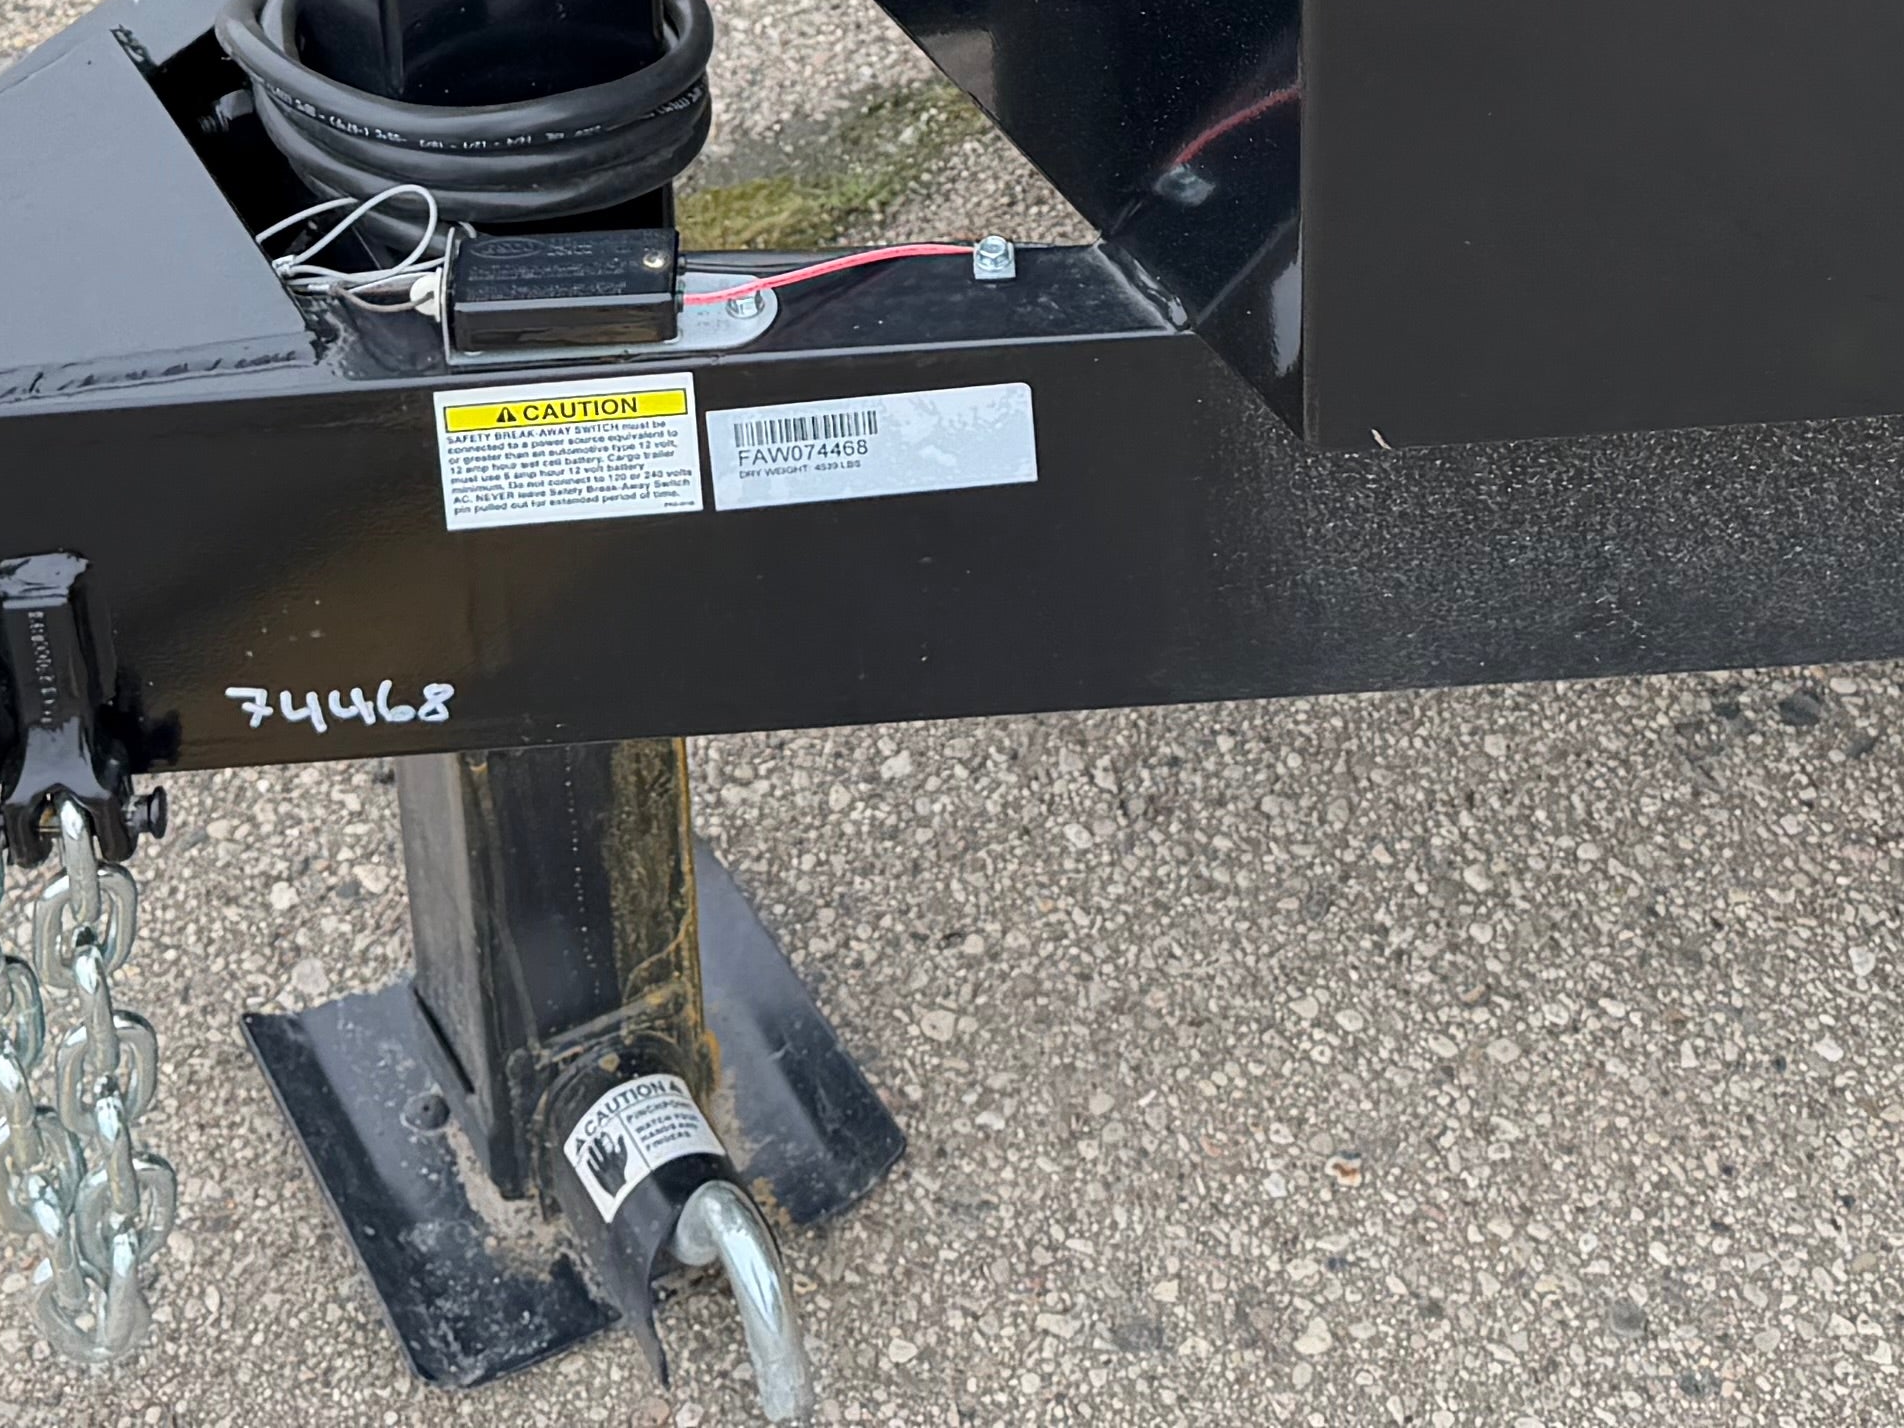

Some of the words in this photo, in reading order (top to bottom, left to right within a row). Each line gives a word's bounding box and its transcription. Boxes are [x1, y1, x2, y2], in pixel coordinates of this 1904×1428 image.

[522, 396, 637, 421] CAUTION
[446, 433, 491, 444] SAFETY
[574, 423, 618, 434] SWITCH
[622, 420, 649, 430] must
[652, 419, 666, 428] be
[447, 442, 504, 454] connected
[507, 441, 518, 450] to
[531, 438, 564, 448] power
[568, 435, 604, 445] source
[607, 430, 664, 442] equivalent
[667, 429, 678, 437] to
[448, 456, 460, 465] or
[463, 453, 501, 464] greater
[505, 451, 529, 461] than
[548, 445, 608, 457] automotive
[612, 442, 635, 452] type
[638, 441, 651, 450] 12
[450, 466, 462, 475] 12
[465, 464, 489, 474] amp
[491, 461, 517, 472] hour
[607, 451, 640, 462] Cargo
[643, 449, 674, 459] trailer
[737, 439, 868, 466] FAW074468
[450, 474, 477, 485] must
[481, 473, 500, 482] use
[539, 467, 565, 477] hour
[568, 466, 580, 475] 12
[606, 461, 644, 472] battery
[508, 481, 523, 489] Do
[526, 479, 544, 488] not
[547, 475, 590, 486] connect
[593, 474, 604, 482] to
[738, 468, 760, 478] DRY
[454, 505, 471, 515] pin
[474, 502, 507, 514] pulled
[510, 500, 528, 510] out
[601, 491, 636, 502] period
[475, 491, 514, 504] NEVER
[549, 485, 582, 497] Safety
[225, 679, 455, 733] 74468
[585, 1080, 666, 1137] CAUTION
